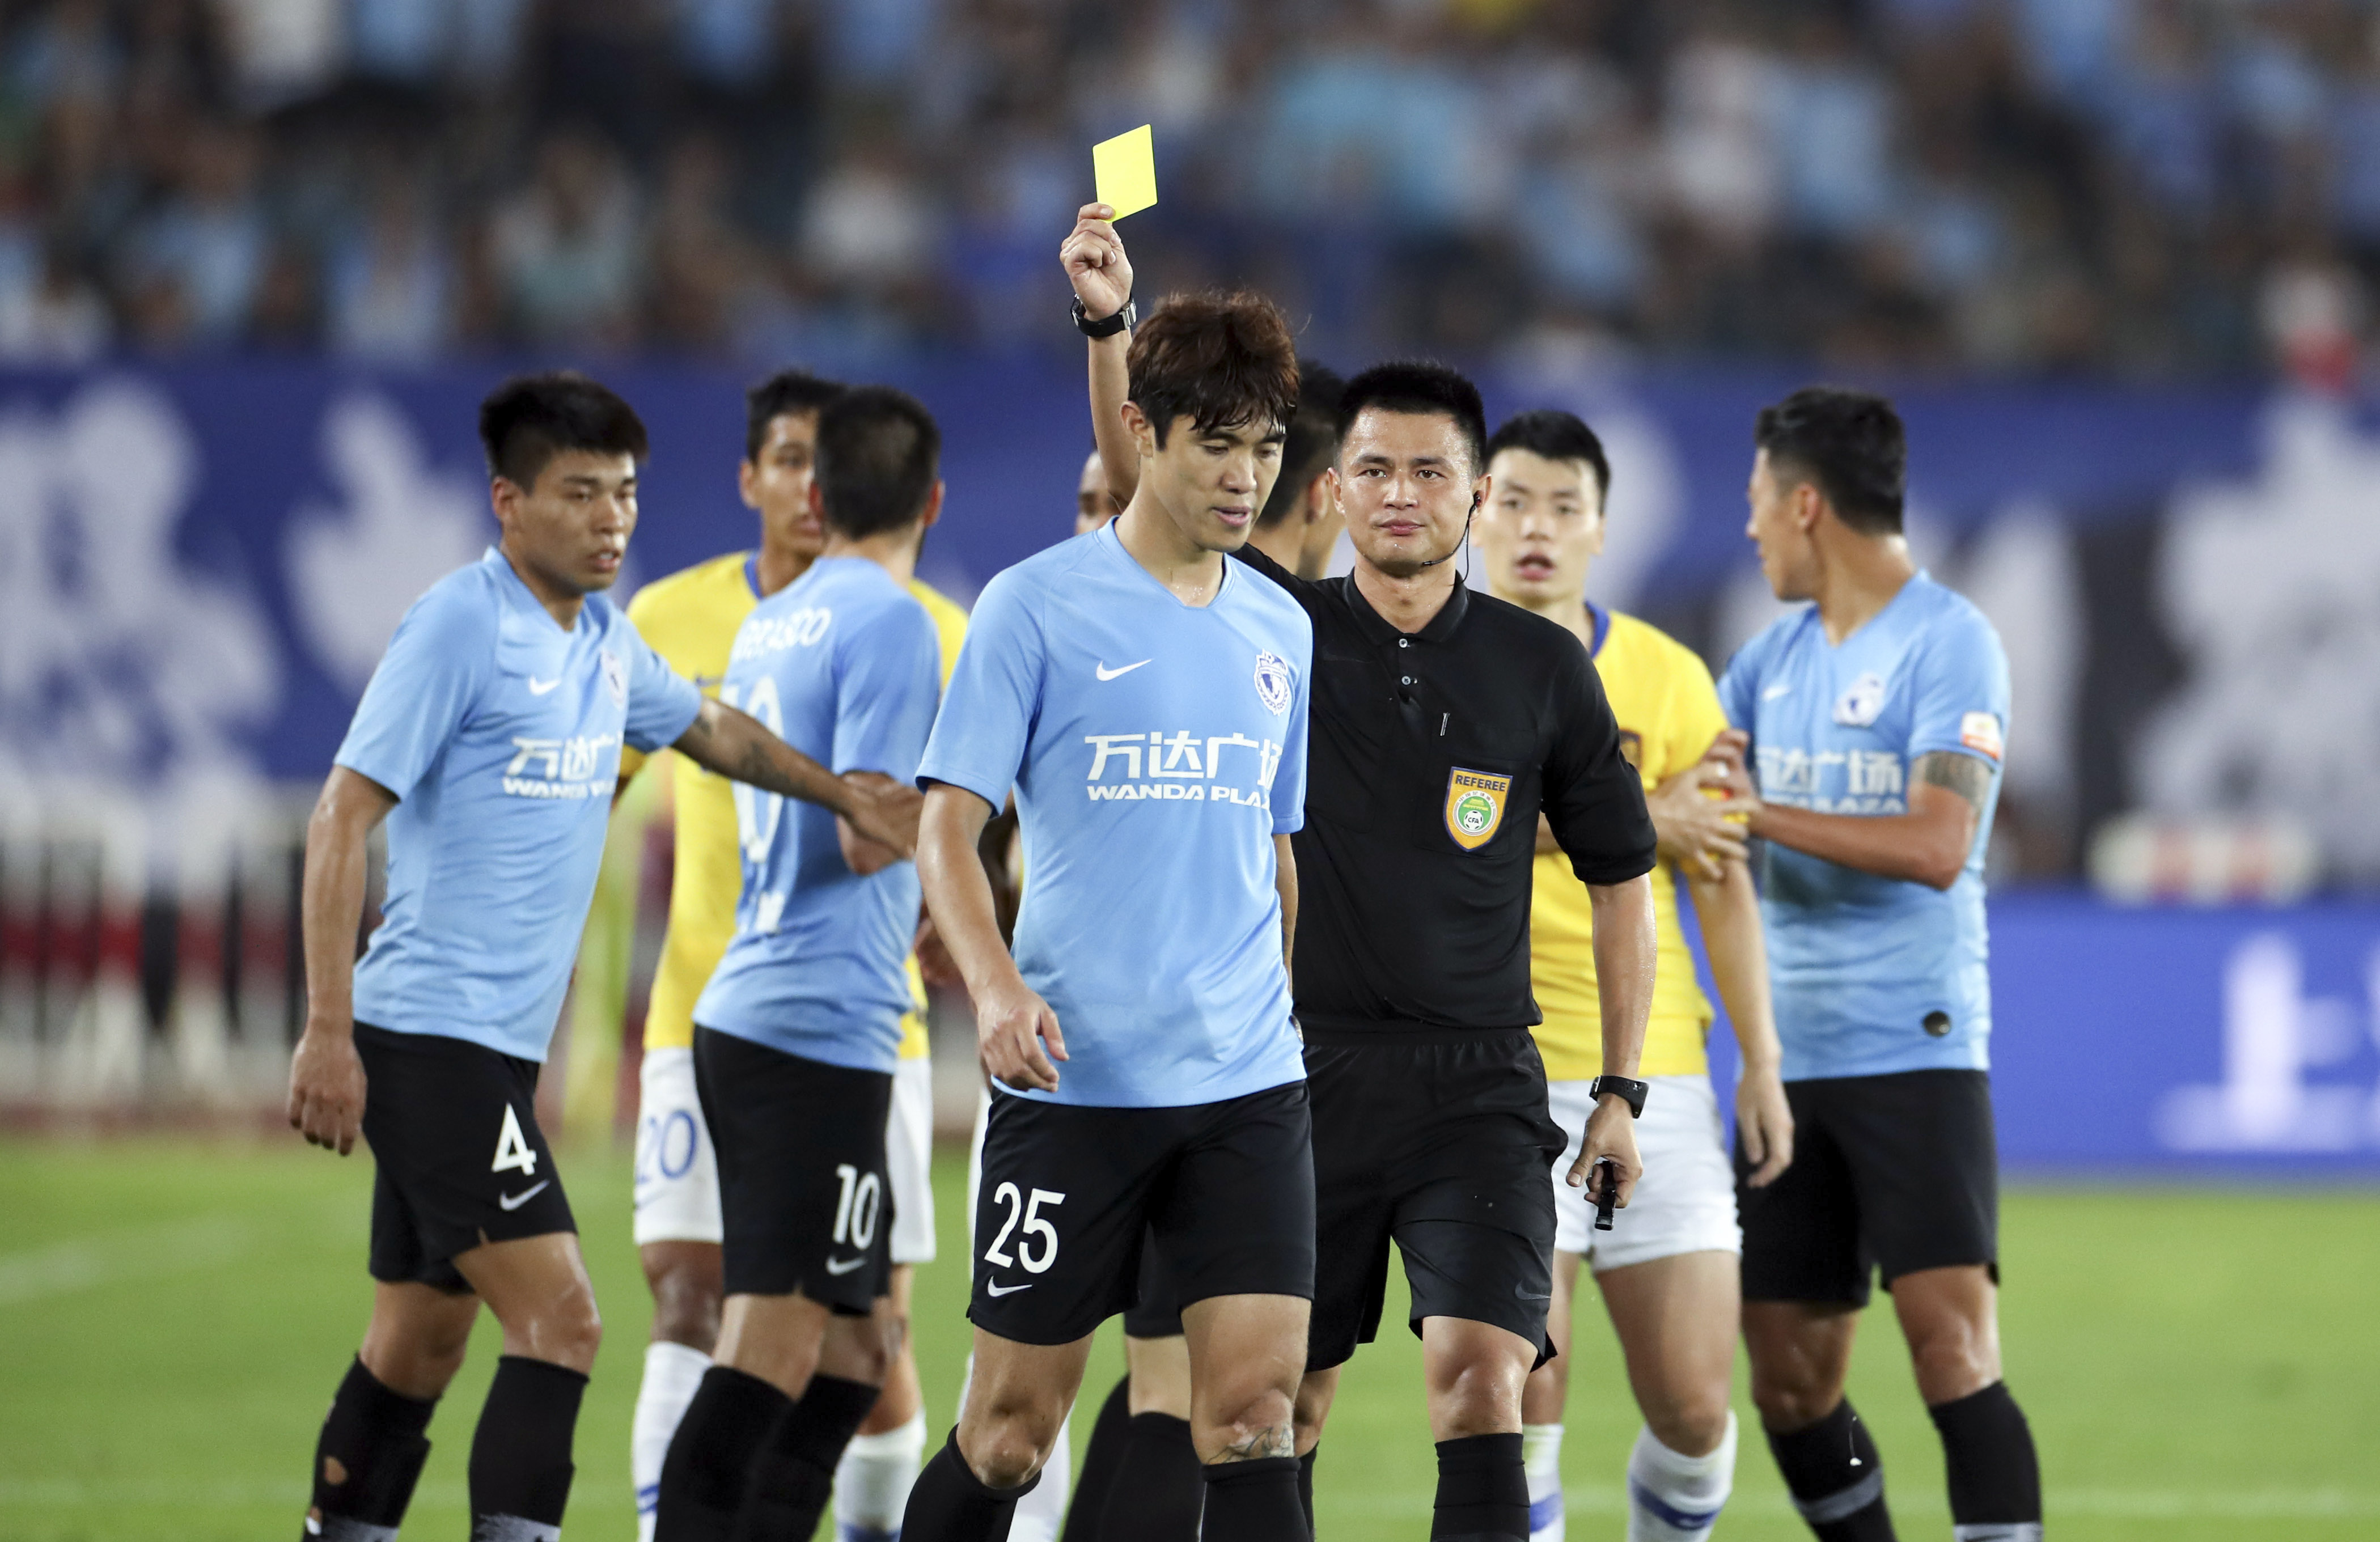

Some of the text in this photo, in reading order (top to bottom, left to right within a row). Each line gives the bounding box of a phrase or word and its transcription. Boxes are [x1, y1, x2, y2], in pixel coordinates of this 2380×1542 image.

[506, 733, 623, 781] 万达广
[1087, 785, 1205, 801] WANDA
[1455, 775, 1506, 791] REFEREE
[2153, 929, 2380, 1152] 上
[491, 1102, 537, 1176] 4
[636, 1108, 698, 1185] 20
[832, 1163, 880, 1251] 10
[984, 1181, 1066, 1274] 25
